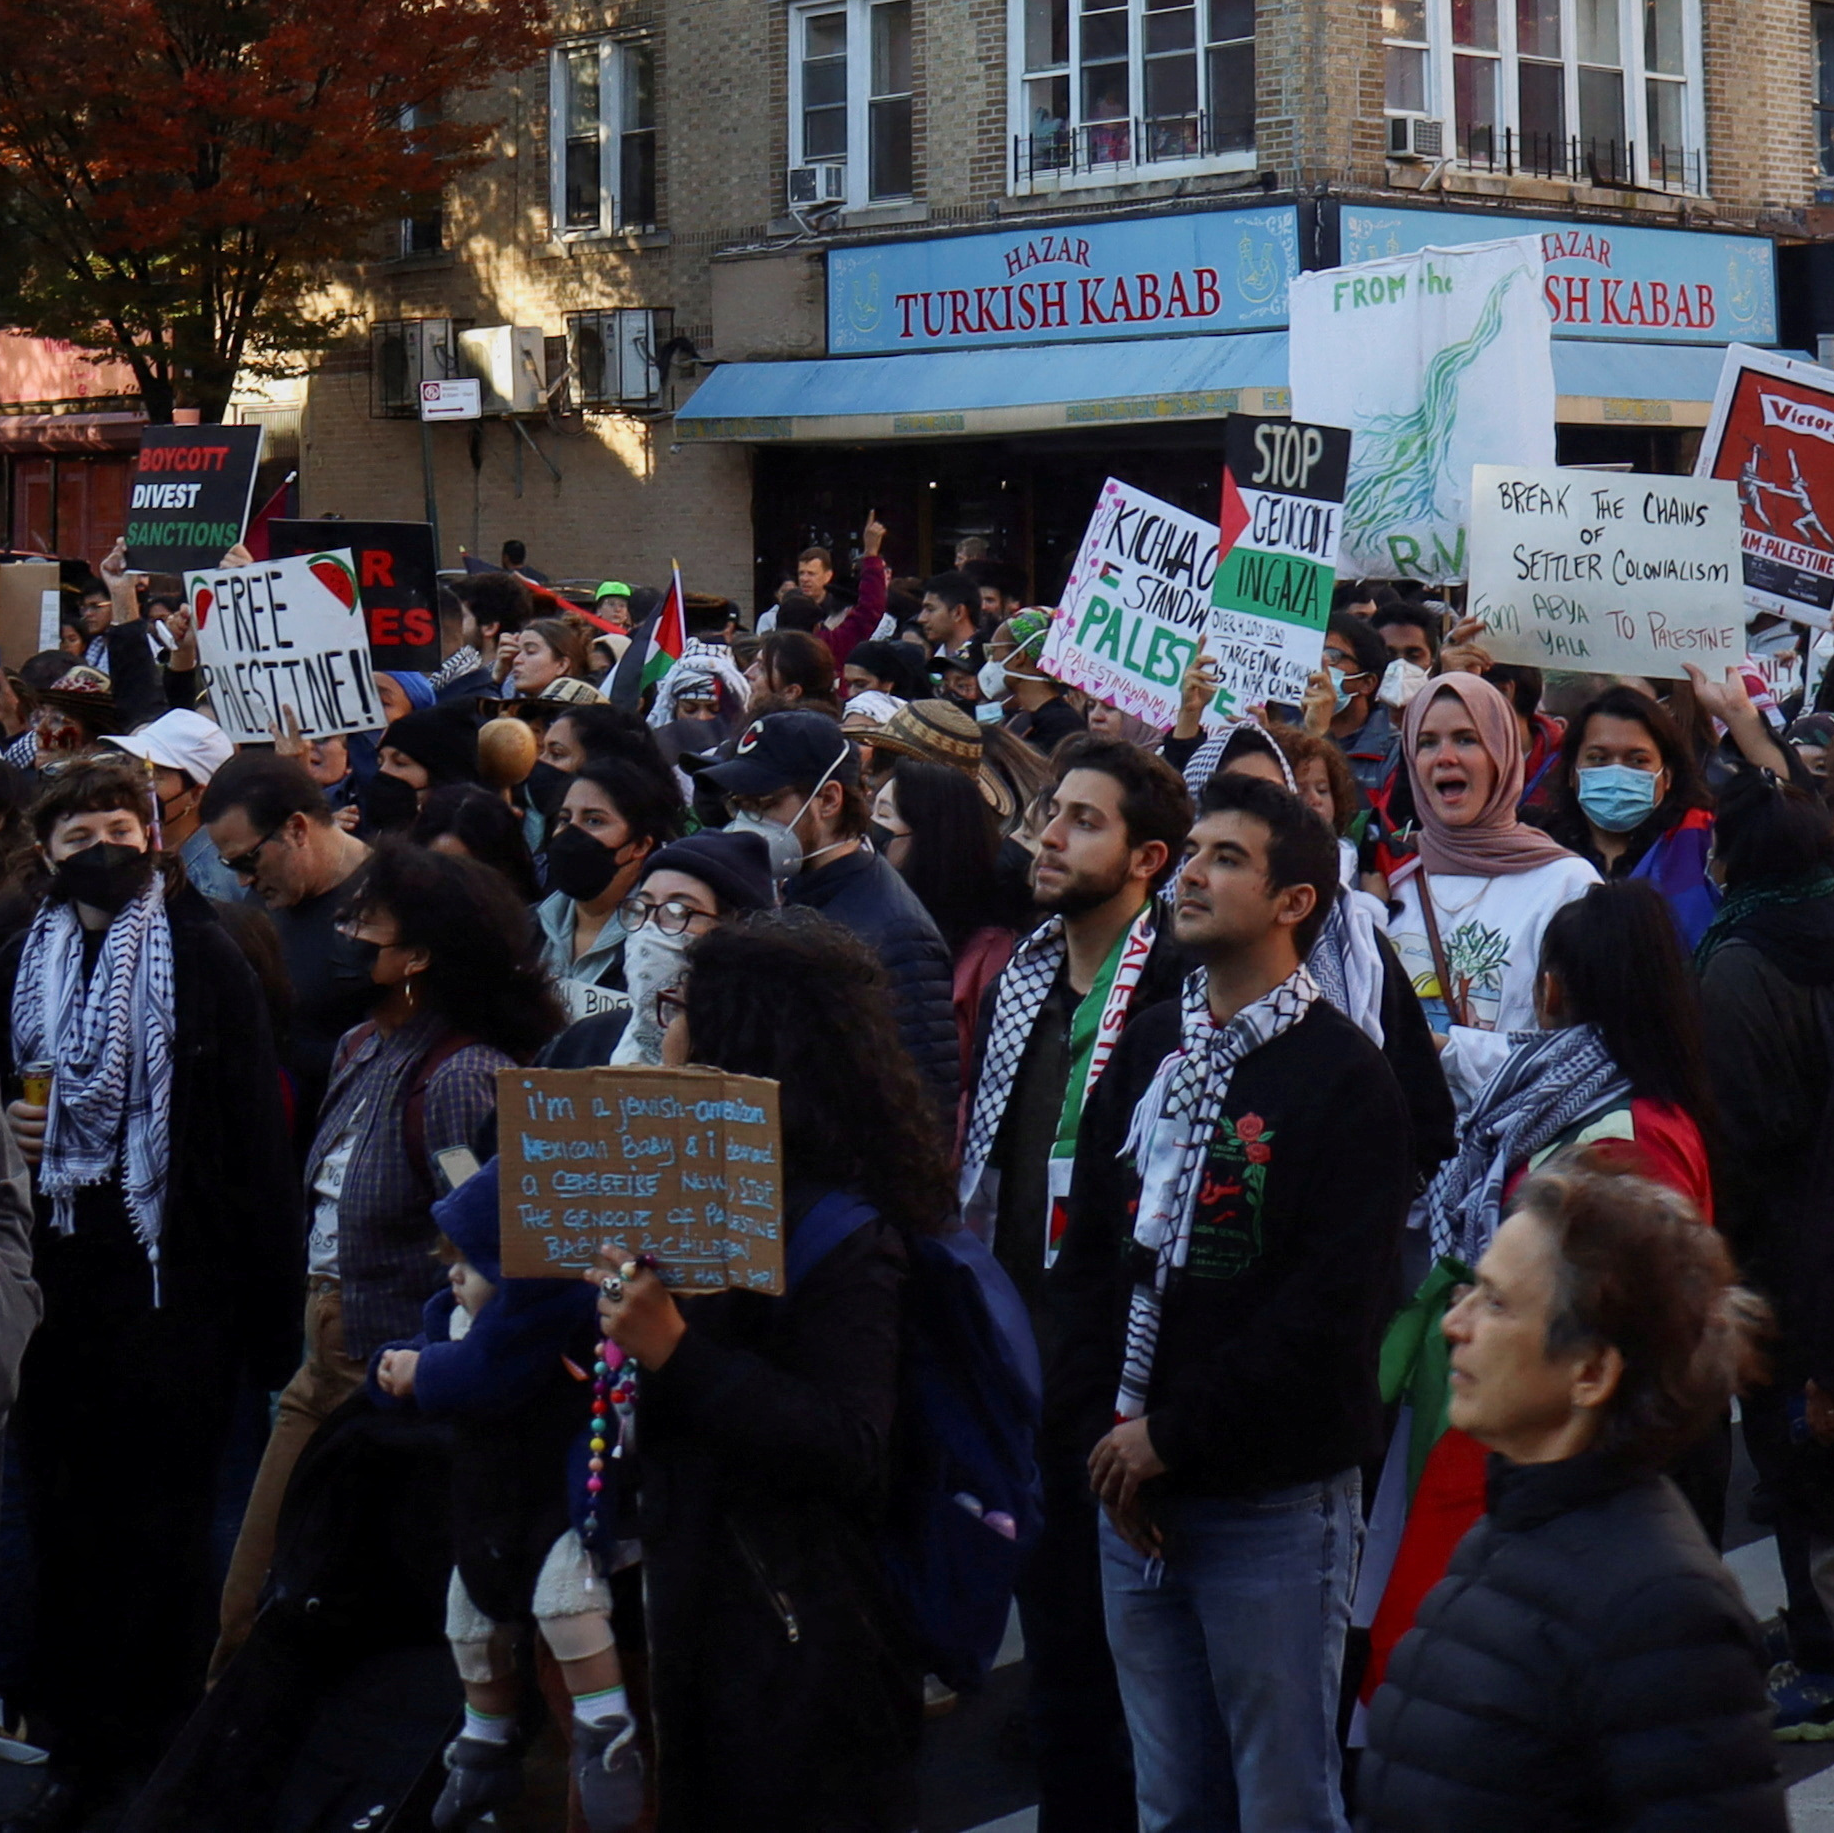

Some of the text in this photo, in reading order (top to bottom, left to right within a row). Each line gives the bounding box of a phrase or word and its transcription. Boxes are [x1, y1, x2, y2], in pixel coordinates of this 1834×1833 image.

[1003, 235, 1092, 279] HAZAR
[895, 268, 1224, 339] TURKISH KABAB
[1333, 273, 1406, 313] FROM
[1600, 279, 1716, 329] KABAB
[138, 445, 230, 473] BOYCOTT
[1251, 422, 1323, 490] STOP
[131, 482, 202, 510] DIVEST
[1497, 481, 1710, 528] BREAK THE CHAINS
[125, 521, 239, 548] SANCTIONS
[1252, 493, 1336, 559] GENOCIDE
[1580, 527, 1605, 545] OF
[1513, 544, 1603, 583] SETTLER
[1611, 548, 1729, 586] COLONIALISM
[1236, 555, 1319, 621] IN GAZA
[214, 571, 295, 653] FREE
[1533, 592, 1591, 625] ABYA
[1605, 610, 1635, 641] TO
[1647, 610, 1735, 653] PALESTINE
[1537, 632, 1591, 658] YALA
[1228, 667, 1238, 690] A
[737, 719, 764, 755] C
